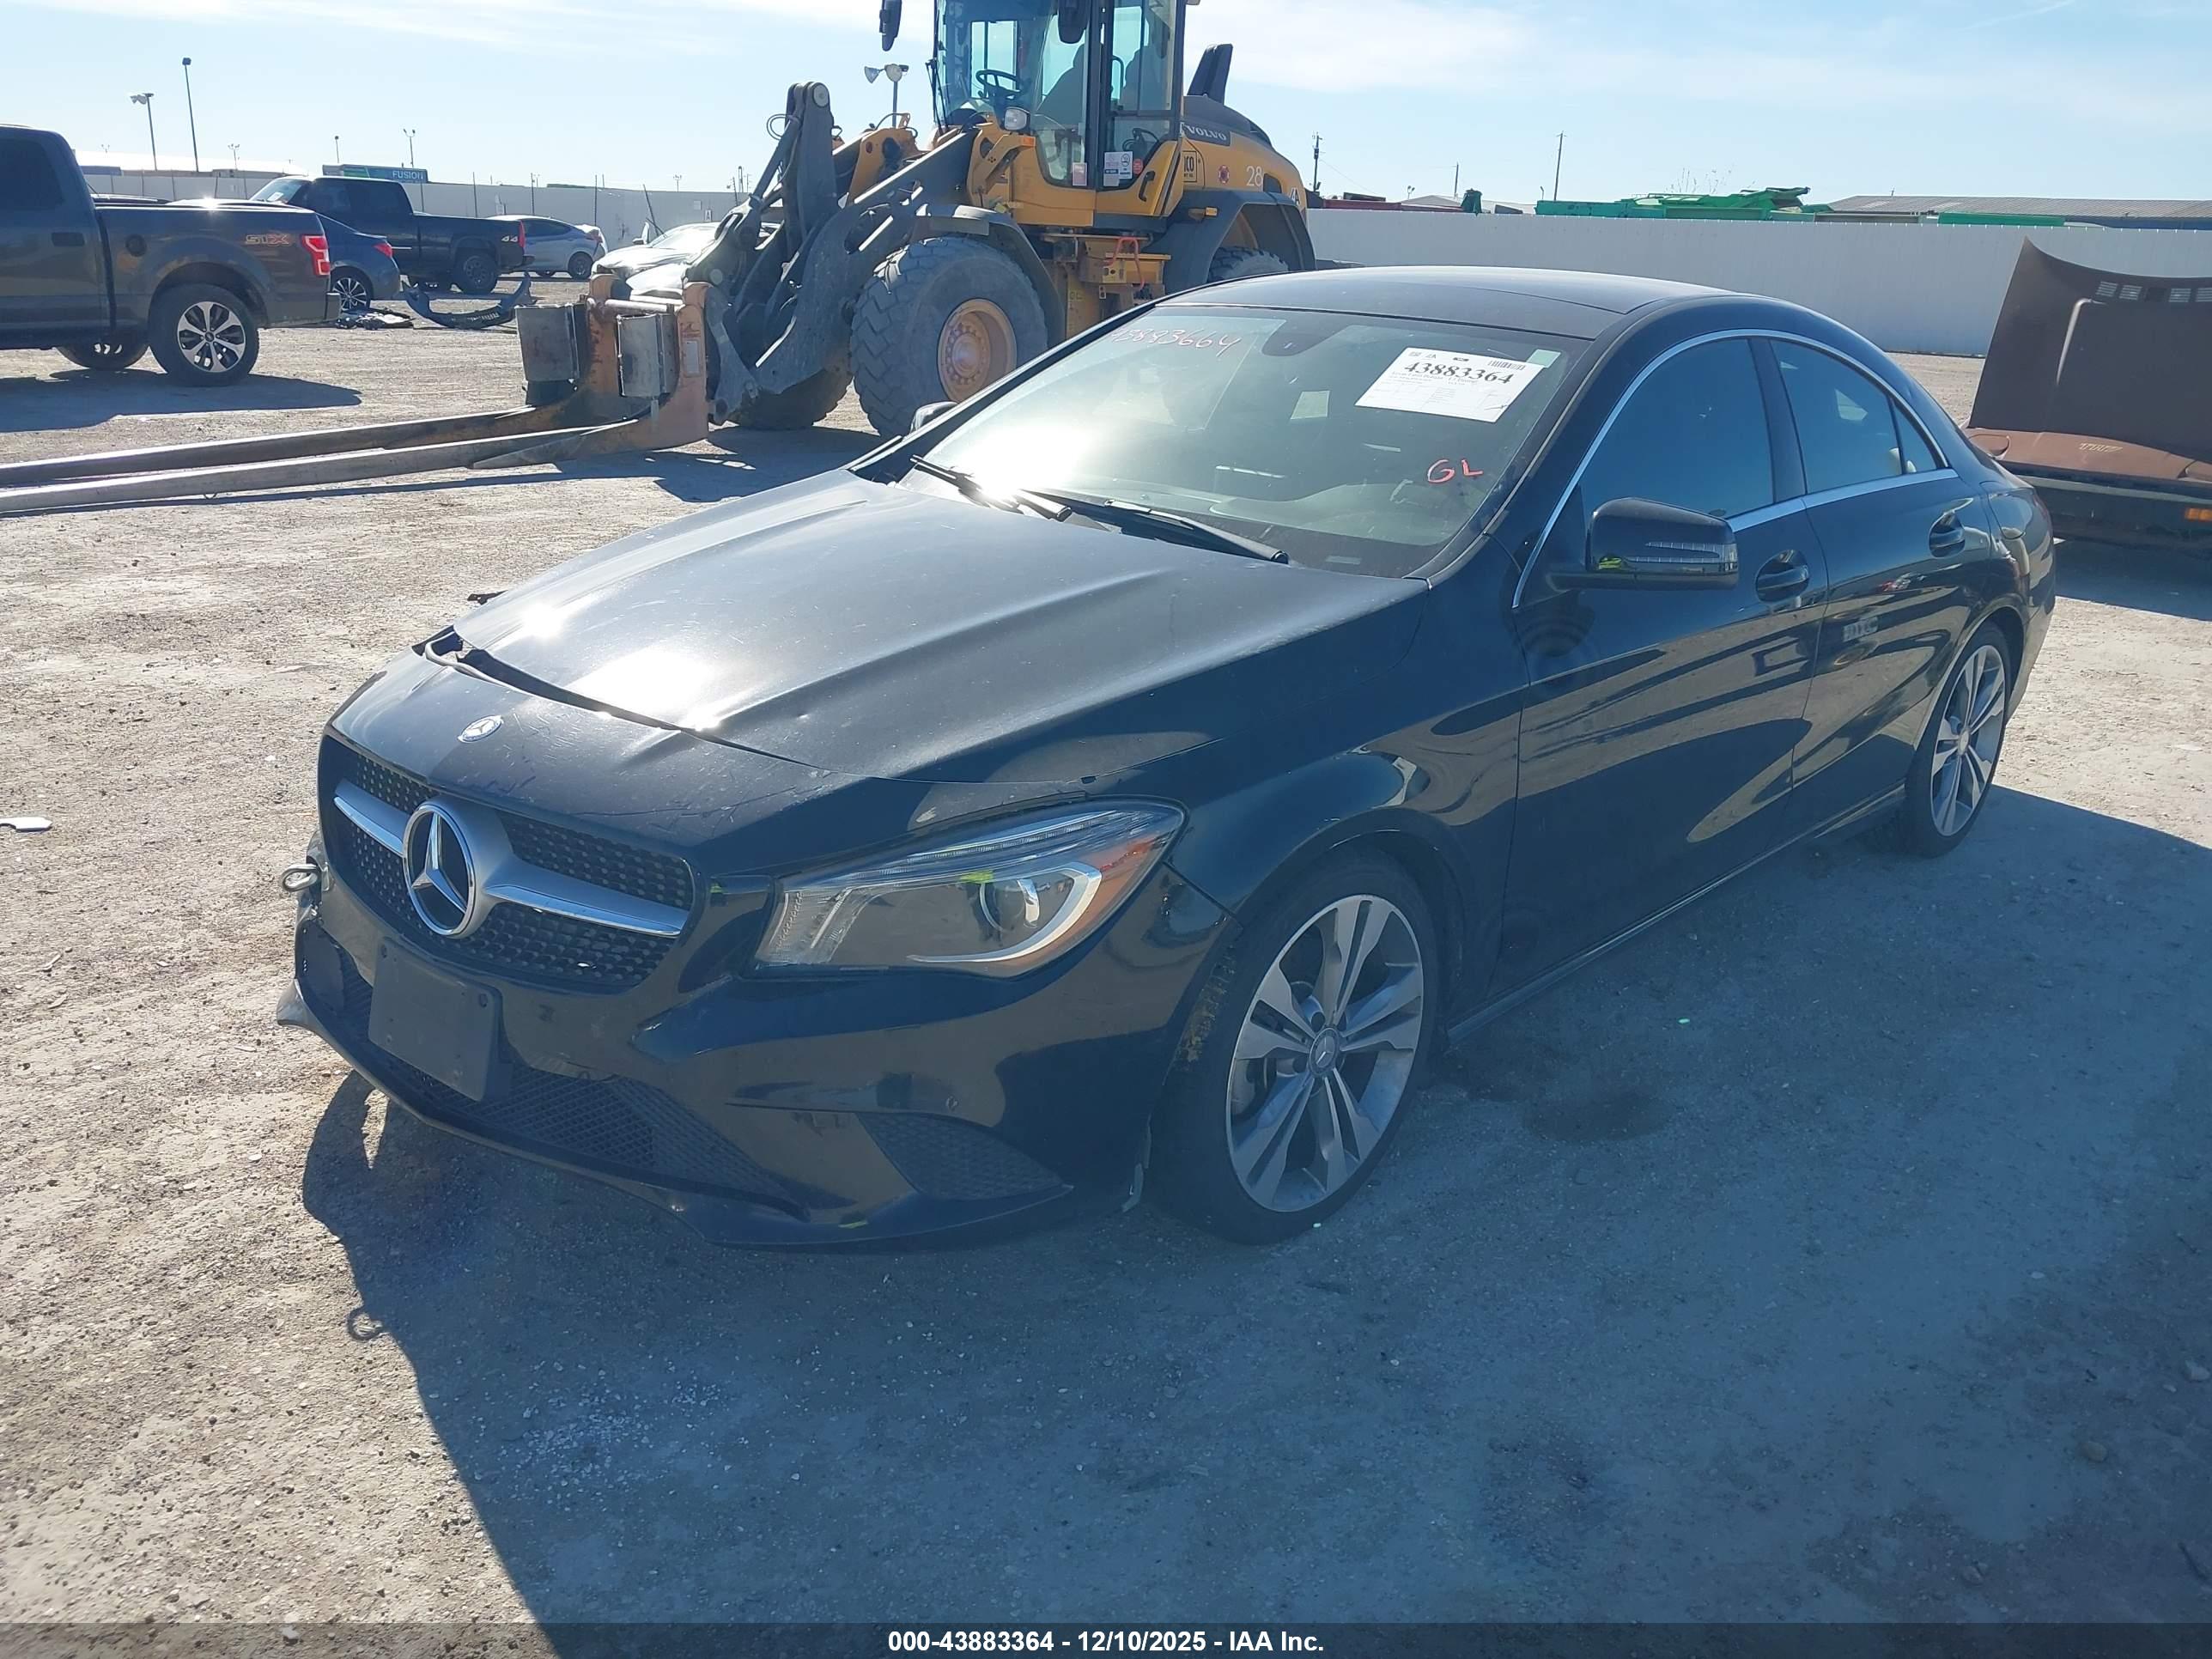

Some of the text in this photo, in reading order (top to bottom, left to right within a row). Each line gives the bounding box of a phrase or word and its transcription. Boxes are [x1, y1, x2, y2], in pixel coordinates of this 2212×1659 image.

[1184, 125, 1227, 141] VOLVO
[392, 170, 424, 179] FUSION
[1246, 165, 1263, 187] 28
[1404, 357, 1515, 385] 43883364
